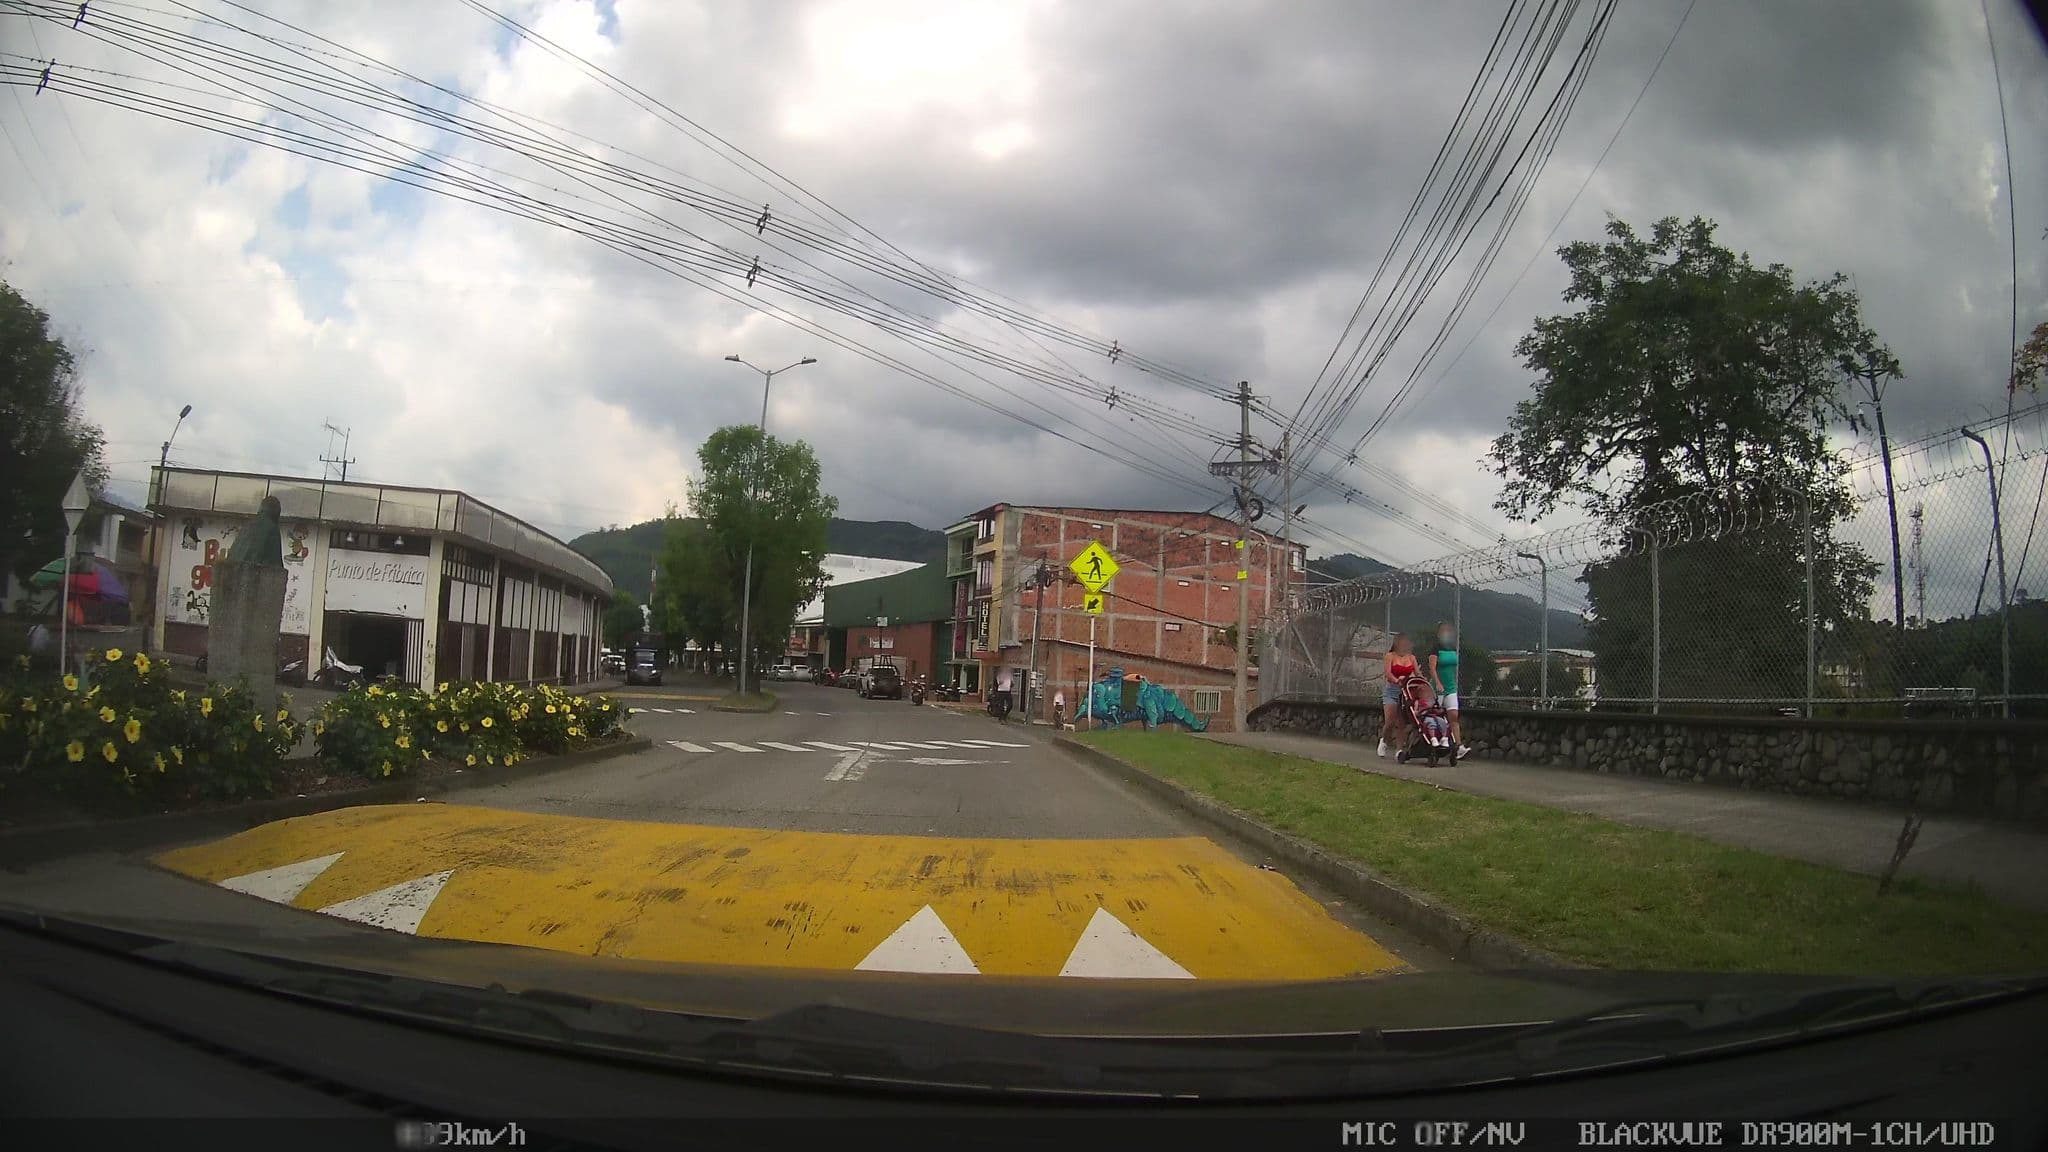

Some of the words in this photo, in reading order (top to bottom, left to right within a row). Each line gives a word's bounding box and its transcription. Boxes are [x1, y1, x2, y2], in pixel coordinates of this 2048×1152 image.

[329, 560, 365, 580] Punto
[366, 562, 381, 581] de
[381, 563, 425, 585] Fábrica
[980, 601, 989, 636] HOTEL
